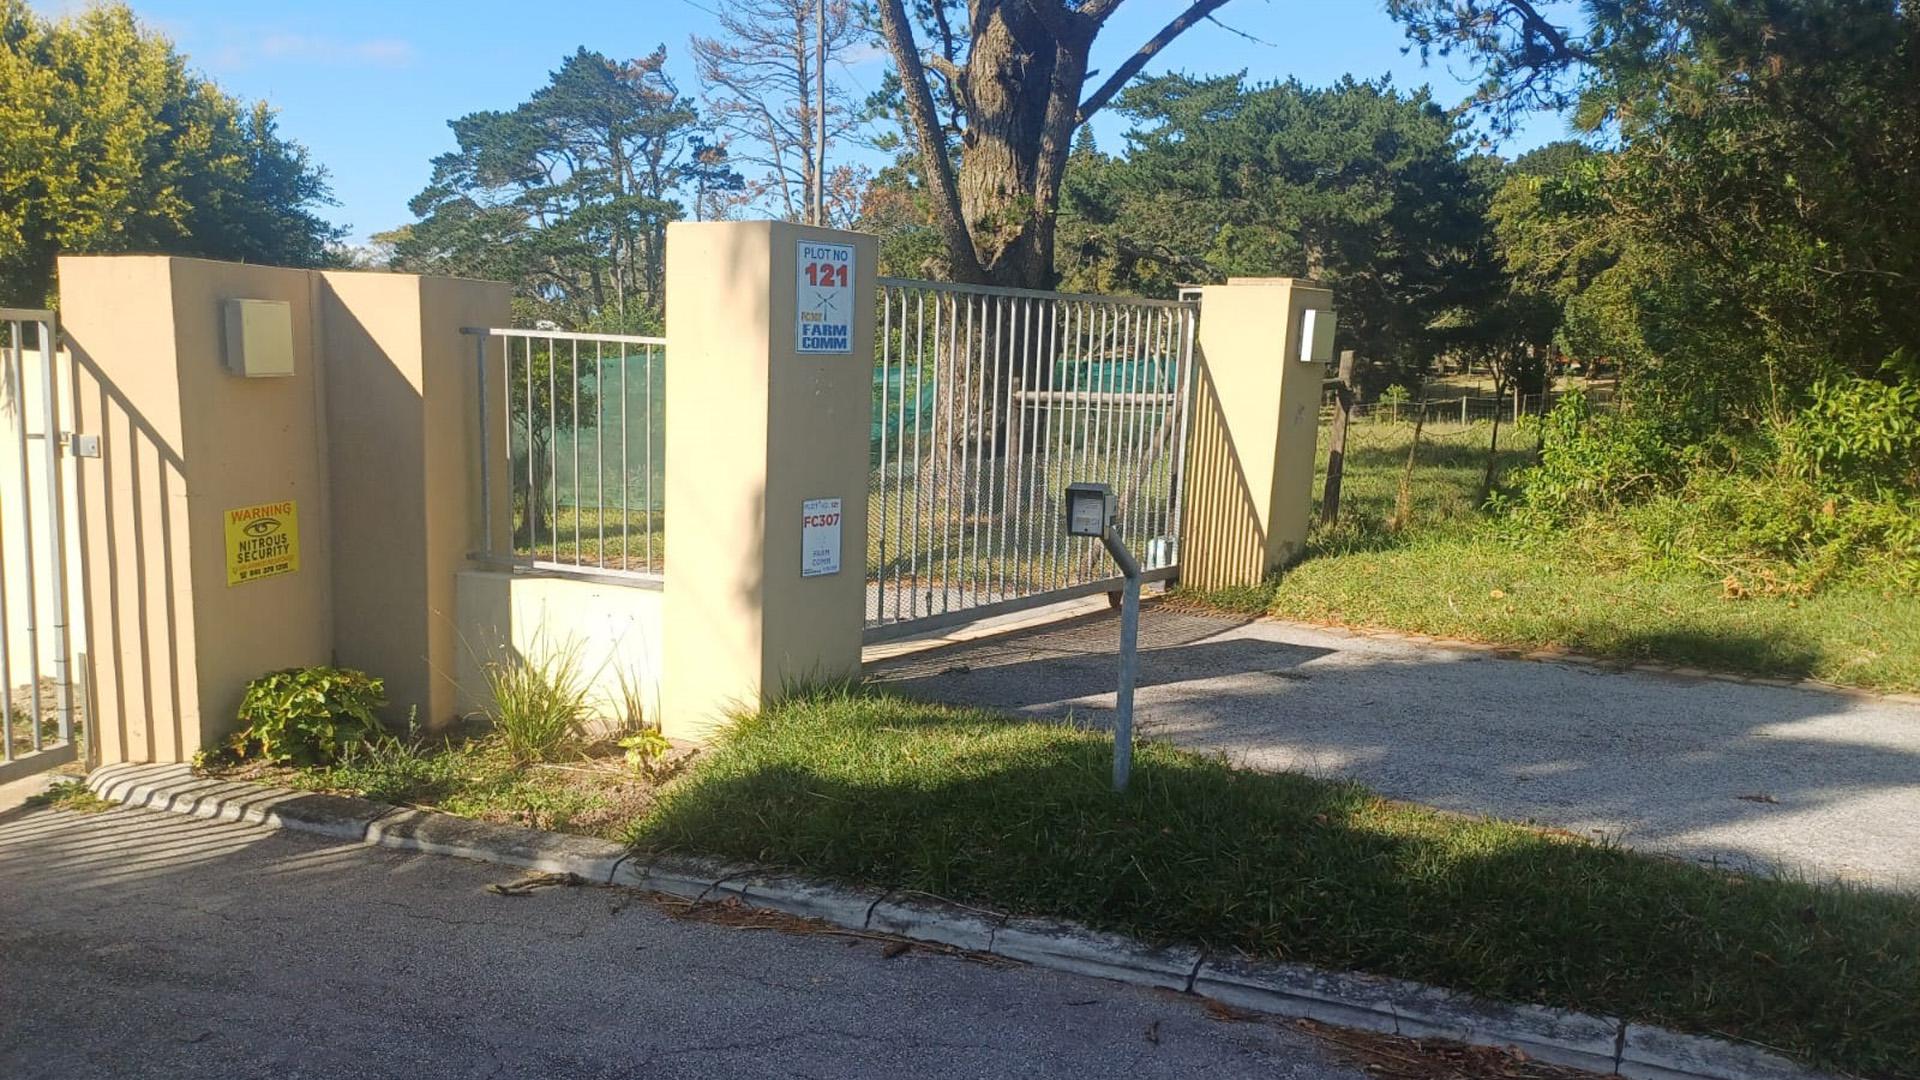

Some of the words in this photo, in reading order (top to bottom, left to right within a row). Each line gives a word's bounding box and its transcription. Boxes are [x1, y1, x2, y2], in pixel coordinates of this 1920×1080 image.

[804, 247, 831, 260] PLOT
[833, 249, 848, 261] NO
[805, 262, 848, 288] 121
[802, 323, 848, 336] FARM
[802, 336, 848, 349] COMM
[231, 503, 292, 524] WARNING
[804, 513, 839, 528] FC307
[239, 533, 288, 553] NITROUS
[237, 544, 289, 563] SECURITY
